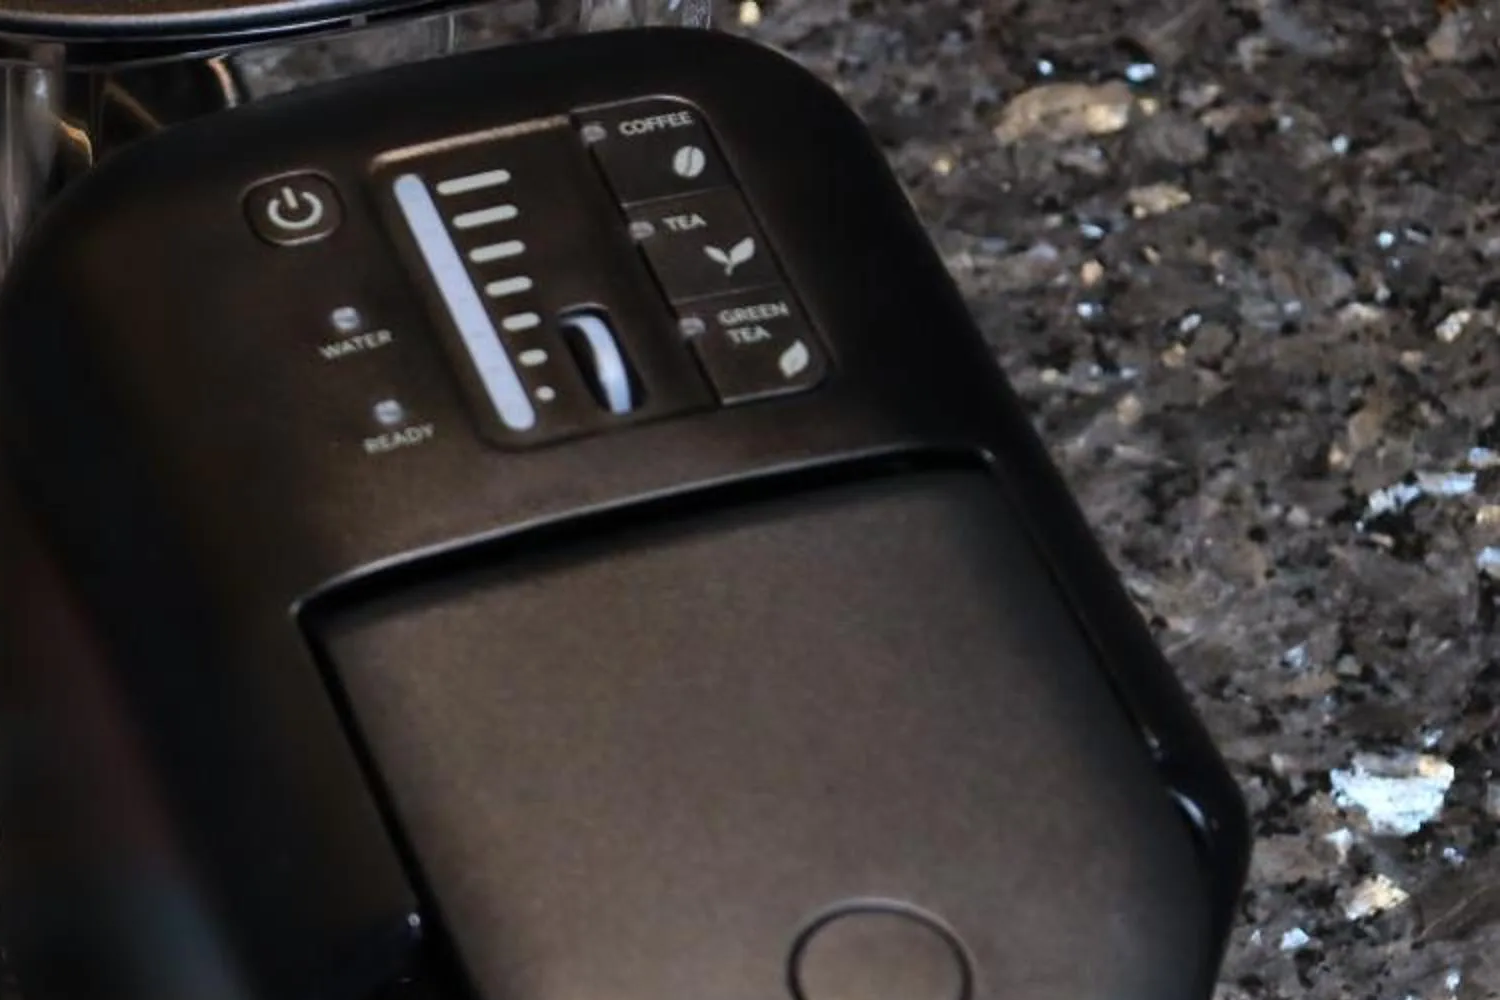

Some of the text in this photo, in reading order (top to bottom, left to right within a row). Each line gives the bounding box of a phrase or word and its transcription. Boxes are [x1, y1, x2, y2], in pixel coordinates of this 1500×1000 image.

[618, 111, 694, 136] COFFEE
[662, 213, 707, 231] TEA
[717, 301, 789, 326] GREEN
[319, 329, 393, 360] WATER
[726, 325, 771, 343] TEA
[363, 422, 435, 454] READY
